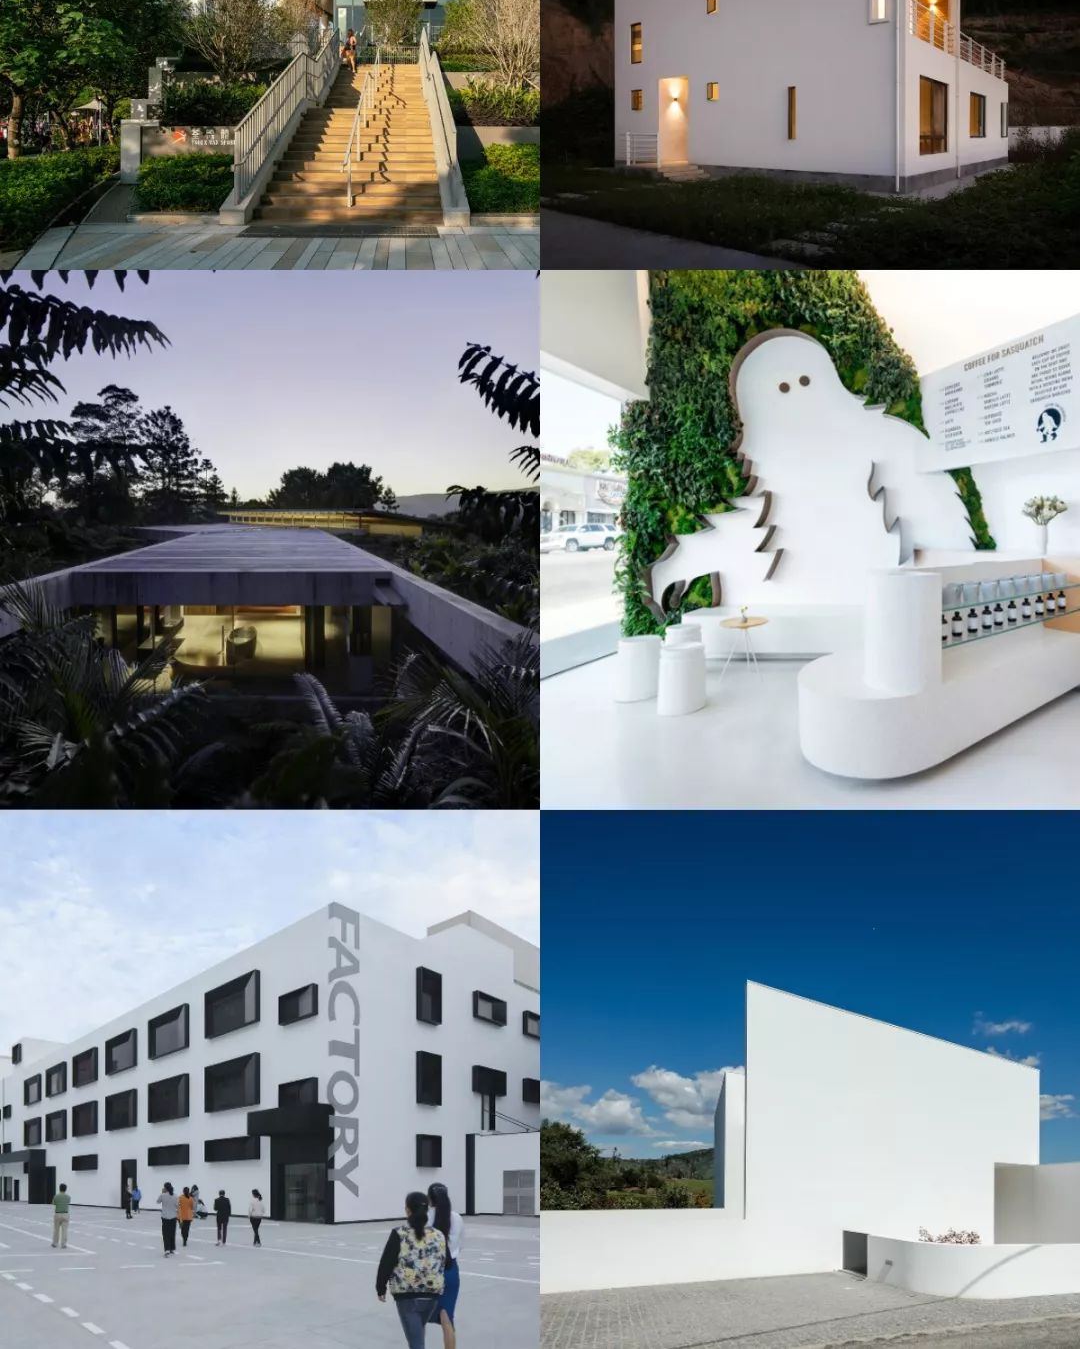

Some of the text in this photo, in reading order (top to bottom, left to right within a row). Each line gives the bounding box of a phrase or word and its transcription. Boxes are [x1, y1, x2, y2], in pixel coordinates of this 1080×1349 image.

[963, 334, 1044, 371] COFFEE FOR SASQUATCH
[327, 902, 361, 1198] FACTORY
